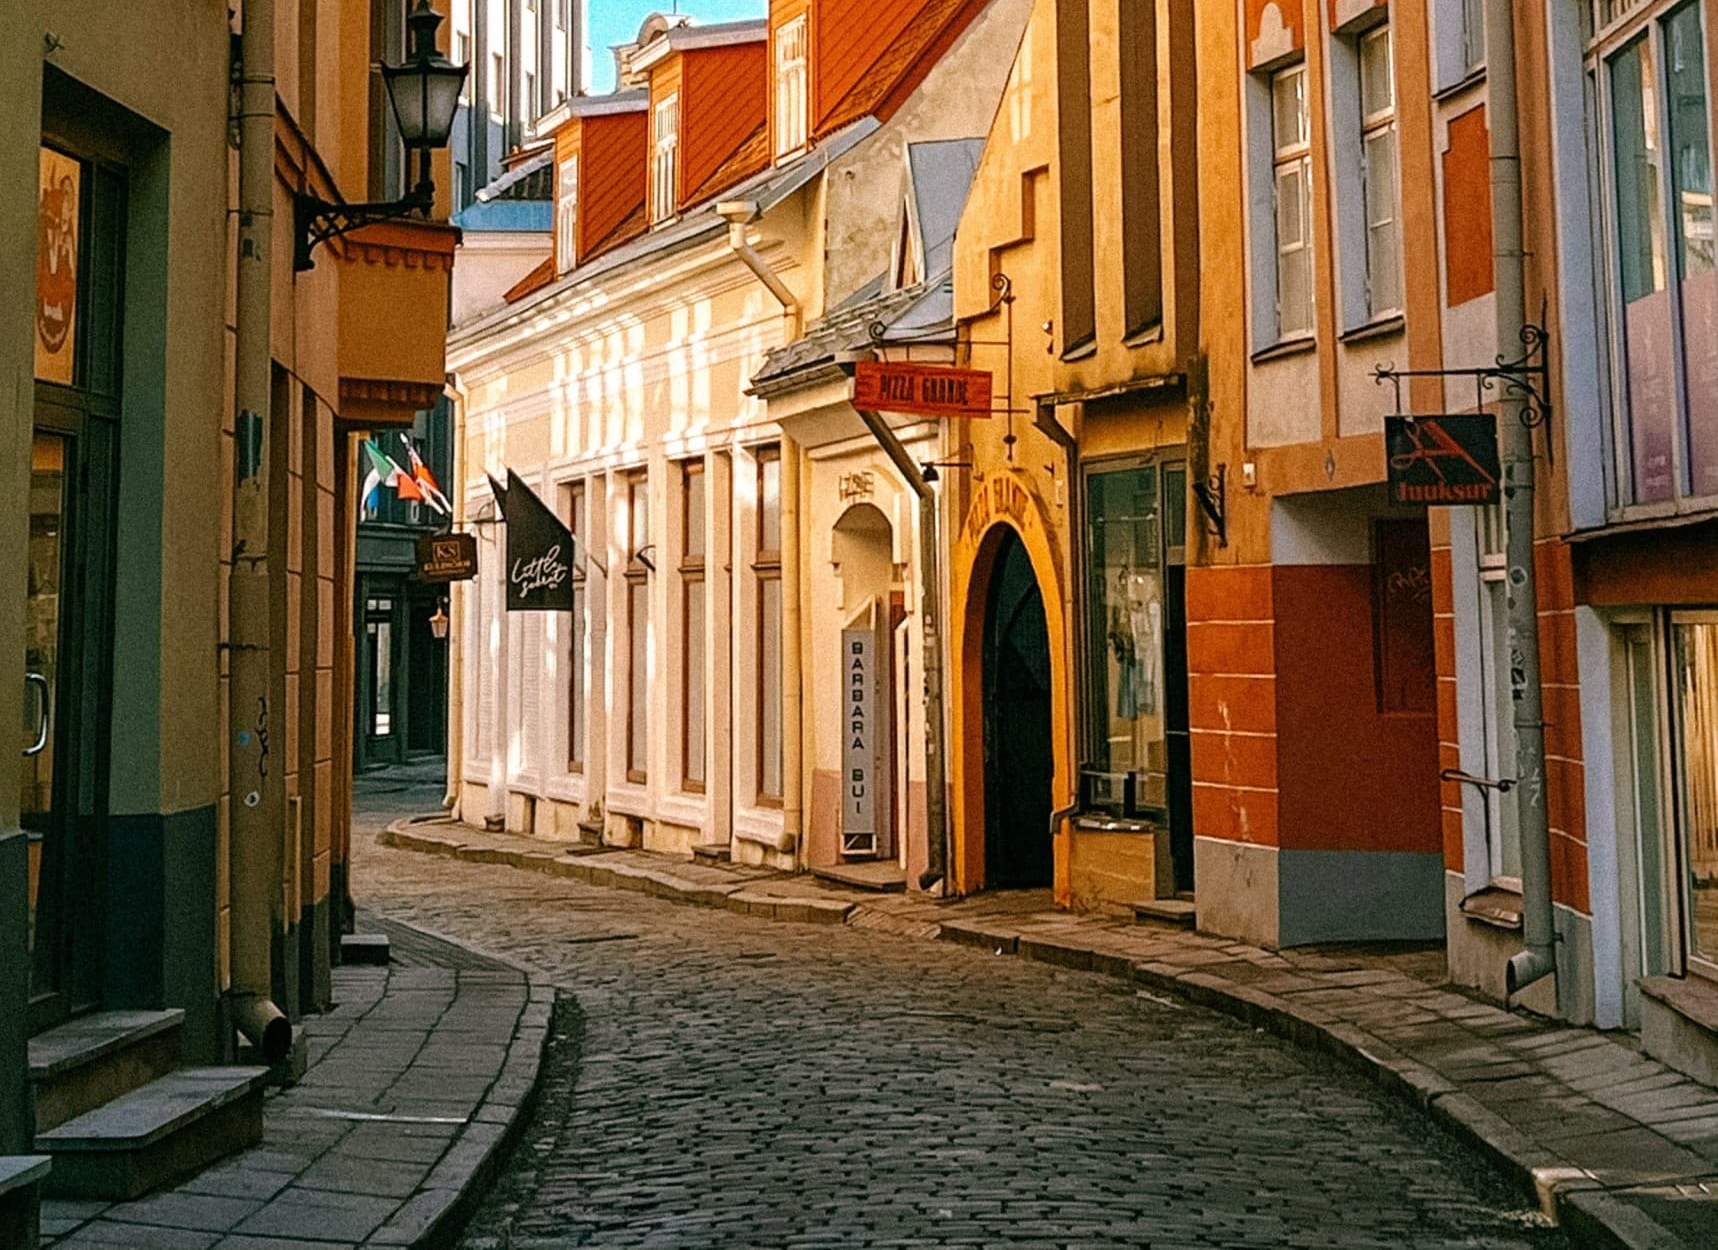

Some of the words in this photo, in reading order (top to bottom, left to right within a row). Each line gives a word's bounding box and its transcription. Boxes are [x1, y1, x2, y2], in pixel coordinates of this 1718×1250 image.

[880, 374, 915, 401] PIZZA
[922, 377, 968, 406] GRANDE
[851, 641, 865, 750] BARBARA
[851, 768, 865, 814] BUI
